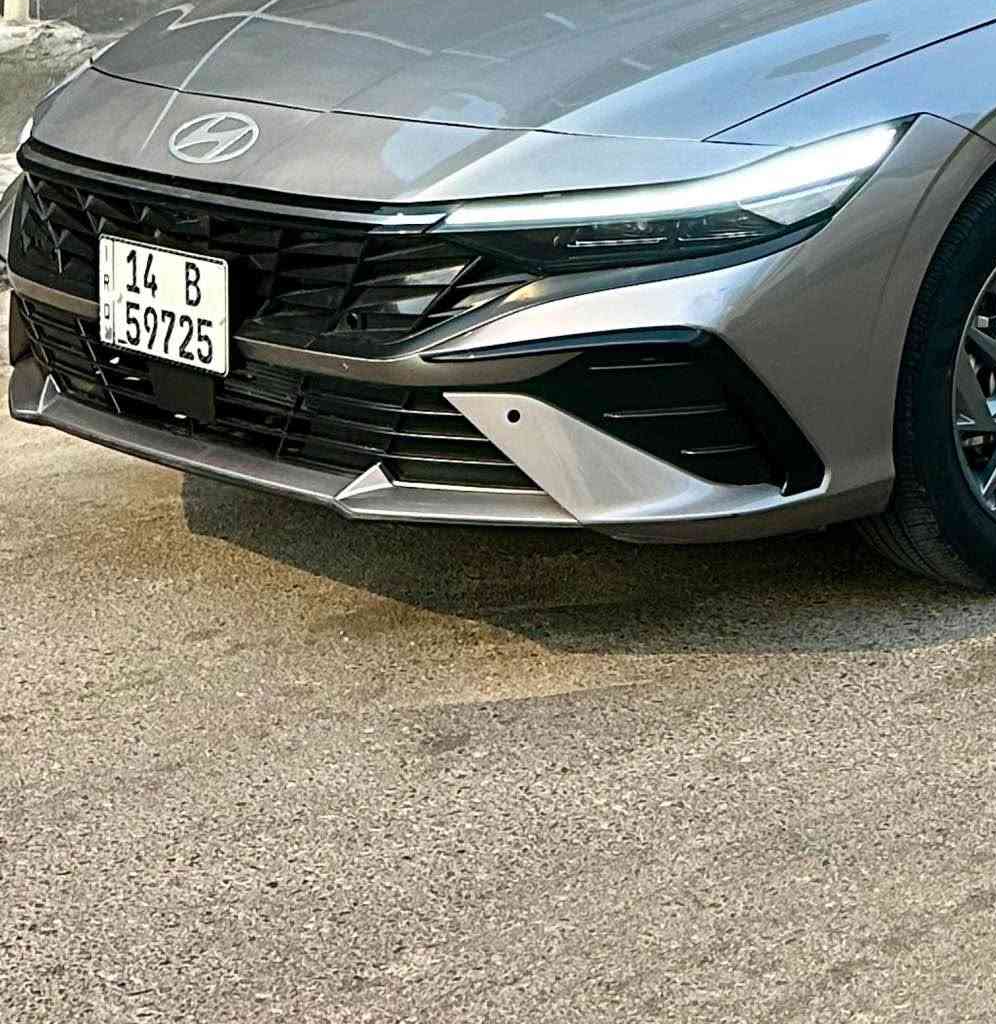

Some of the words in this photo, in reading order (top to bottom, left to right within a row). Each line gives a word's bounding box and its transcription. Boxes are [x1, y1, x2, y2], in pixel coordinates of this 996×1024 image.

[126, 249, 158, 298] 14
[185, 261, 201, 306] B
[126, 301, 213, 364] 59725
